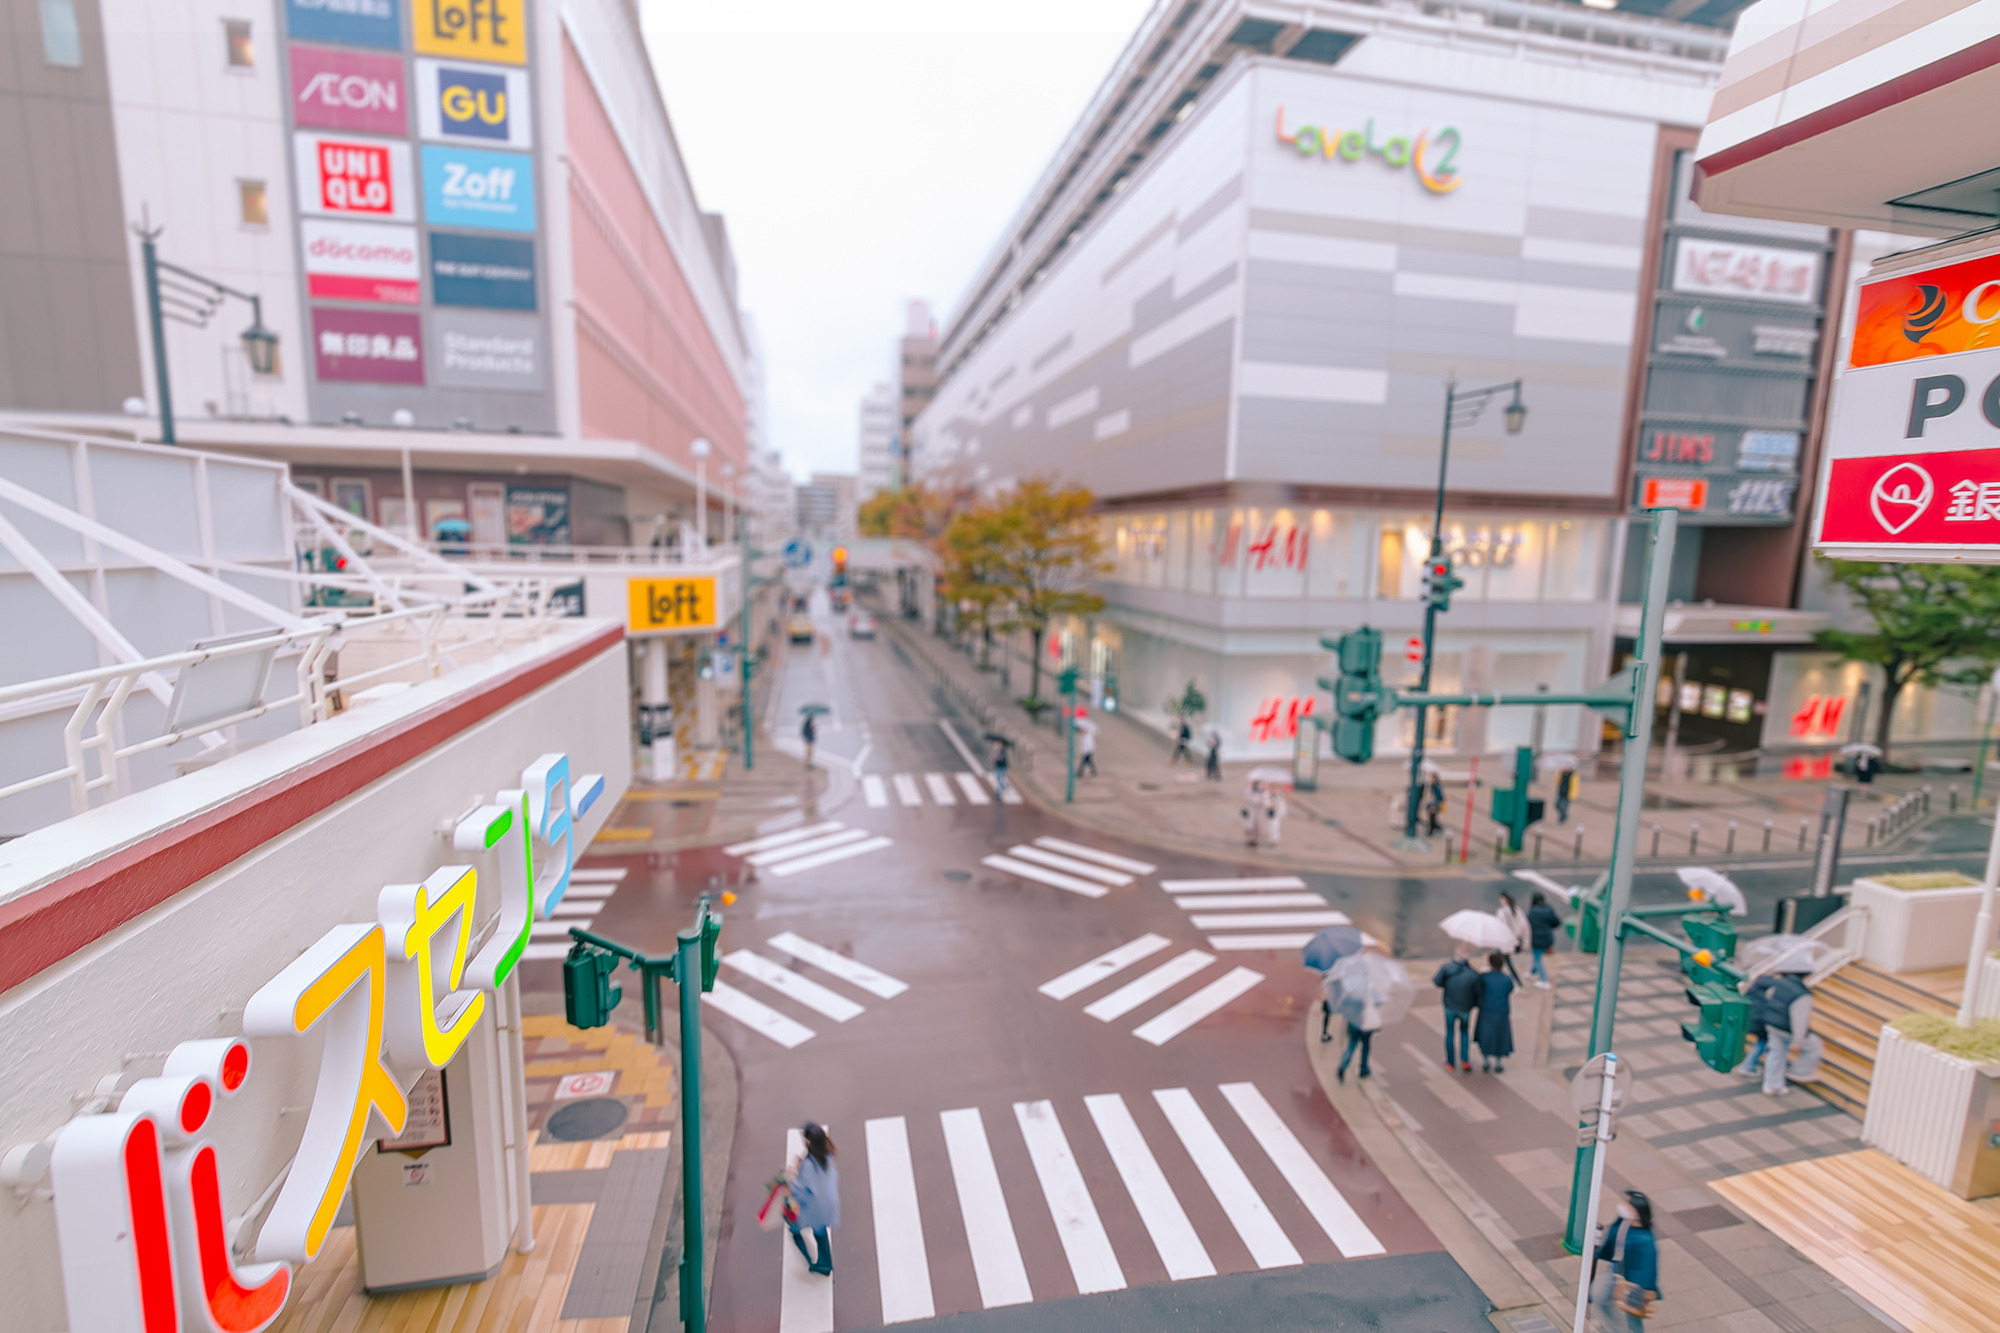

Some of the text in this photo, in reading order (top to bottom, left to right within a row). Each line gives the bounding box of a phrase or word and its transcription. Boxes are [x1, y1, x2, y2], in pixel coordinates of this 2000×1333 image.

[441, 85, 507, 124] GU
[323, 147, 381, 178] UNI
[326, 178, 387, 208] QLO
[442, 163, 515, 201] Zoff
[320, 331, 418, 361] 無印良品
[444, 332, 534, 355] Standard
[444, 355, 535, 374] Products
[1648, 432, 1715, 463] JINS
